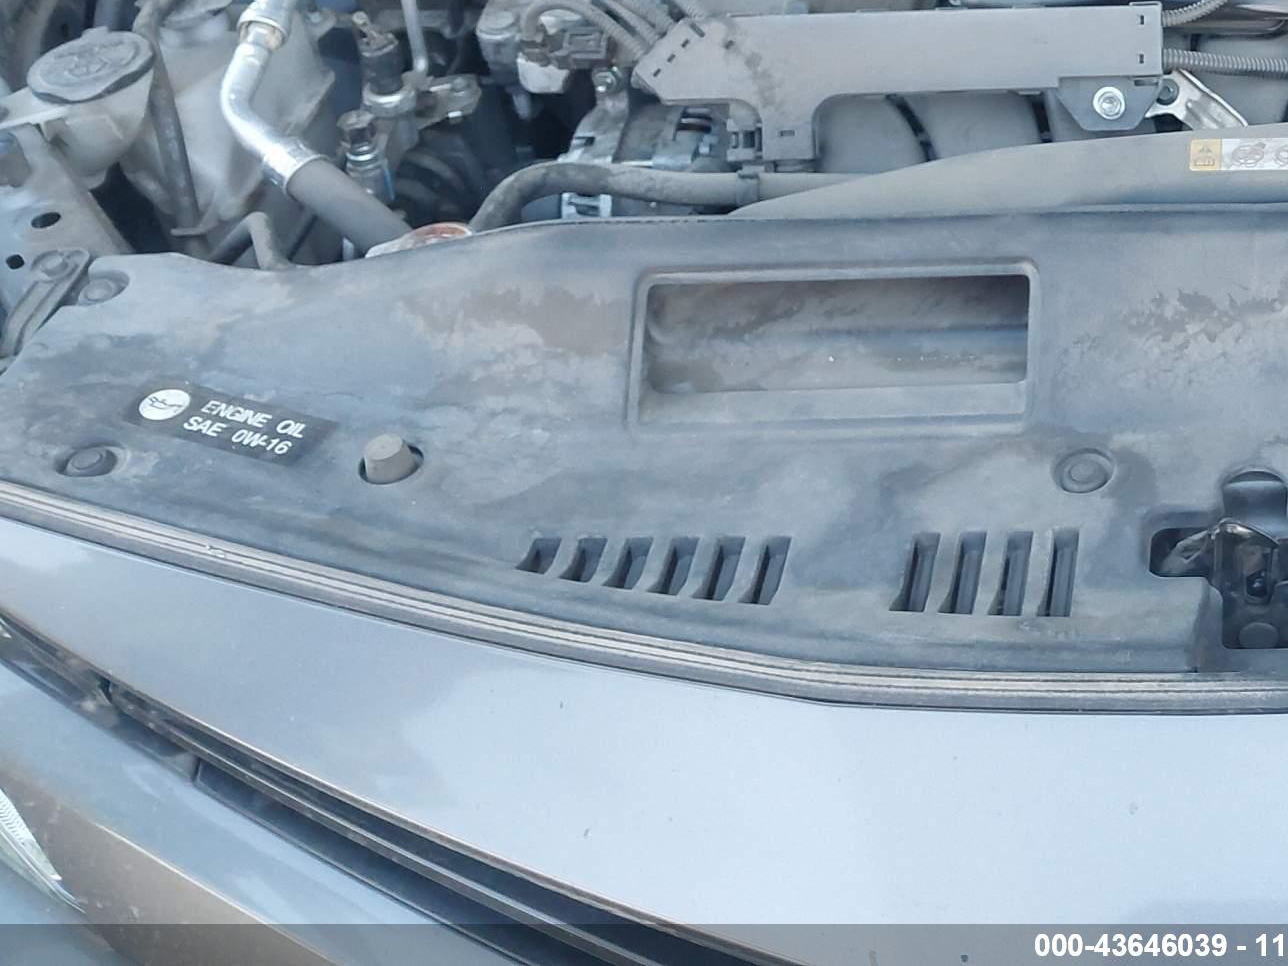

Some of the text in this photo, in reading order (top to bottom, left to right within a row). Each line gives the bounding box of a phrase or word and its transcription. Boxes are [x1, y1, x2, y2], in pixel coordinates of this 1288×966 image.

[183, 416, 292, 454] SAE 0W-16
[201, 400, 306, 438] ENGINE OIL
